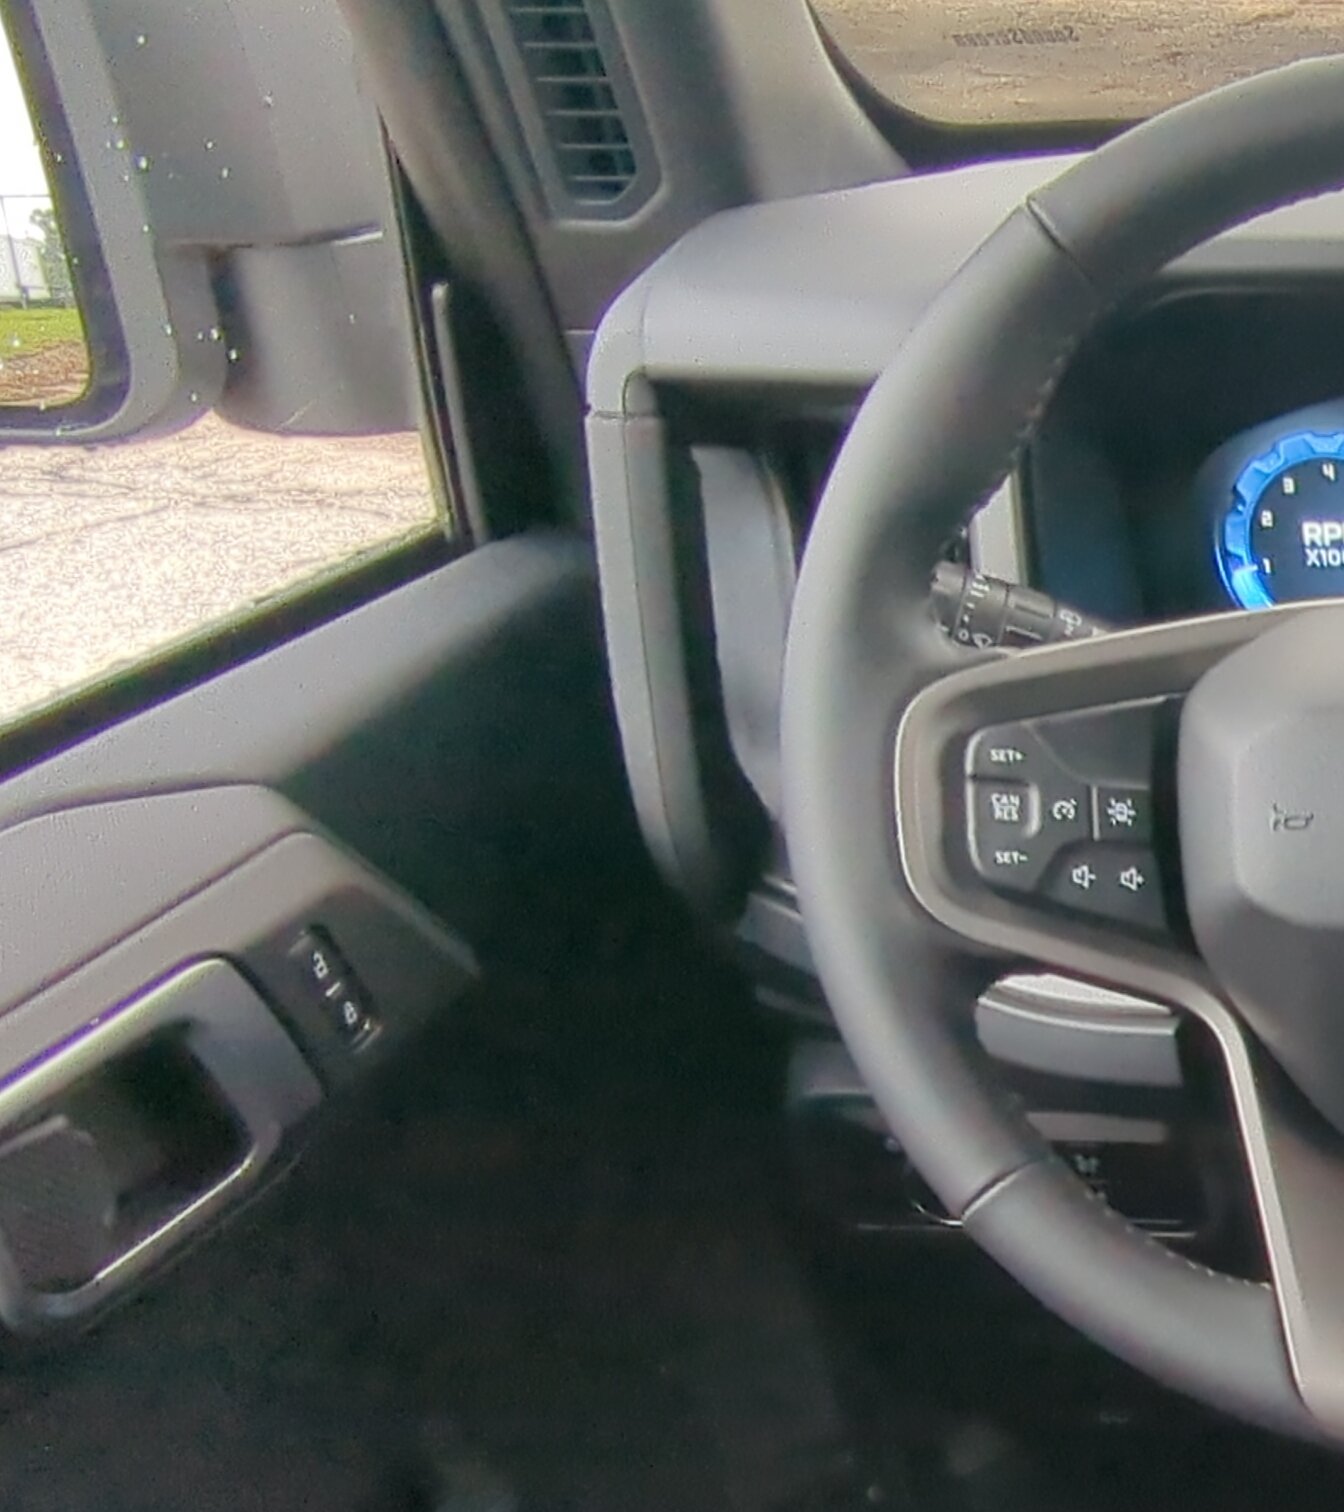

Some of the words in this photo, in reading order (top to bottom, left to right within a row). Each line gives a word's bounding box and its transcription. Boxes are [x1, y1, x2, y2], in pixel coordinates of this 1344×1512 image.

[1321, 463, 1335, 481] 4
[1283, 477, 1295, 494] 3
[1261, 511, 1273, 528] 2
[1262, 558, 1271, 574] 1
